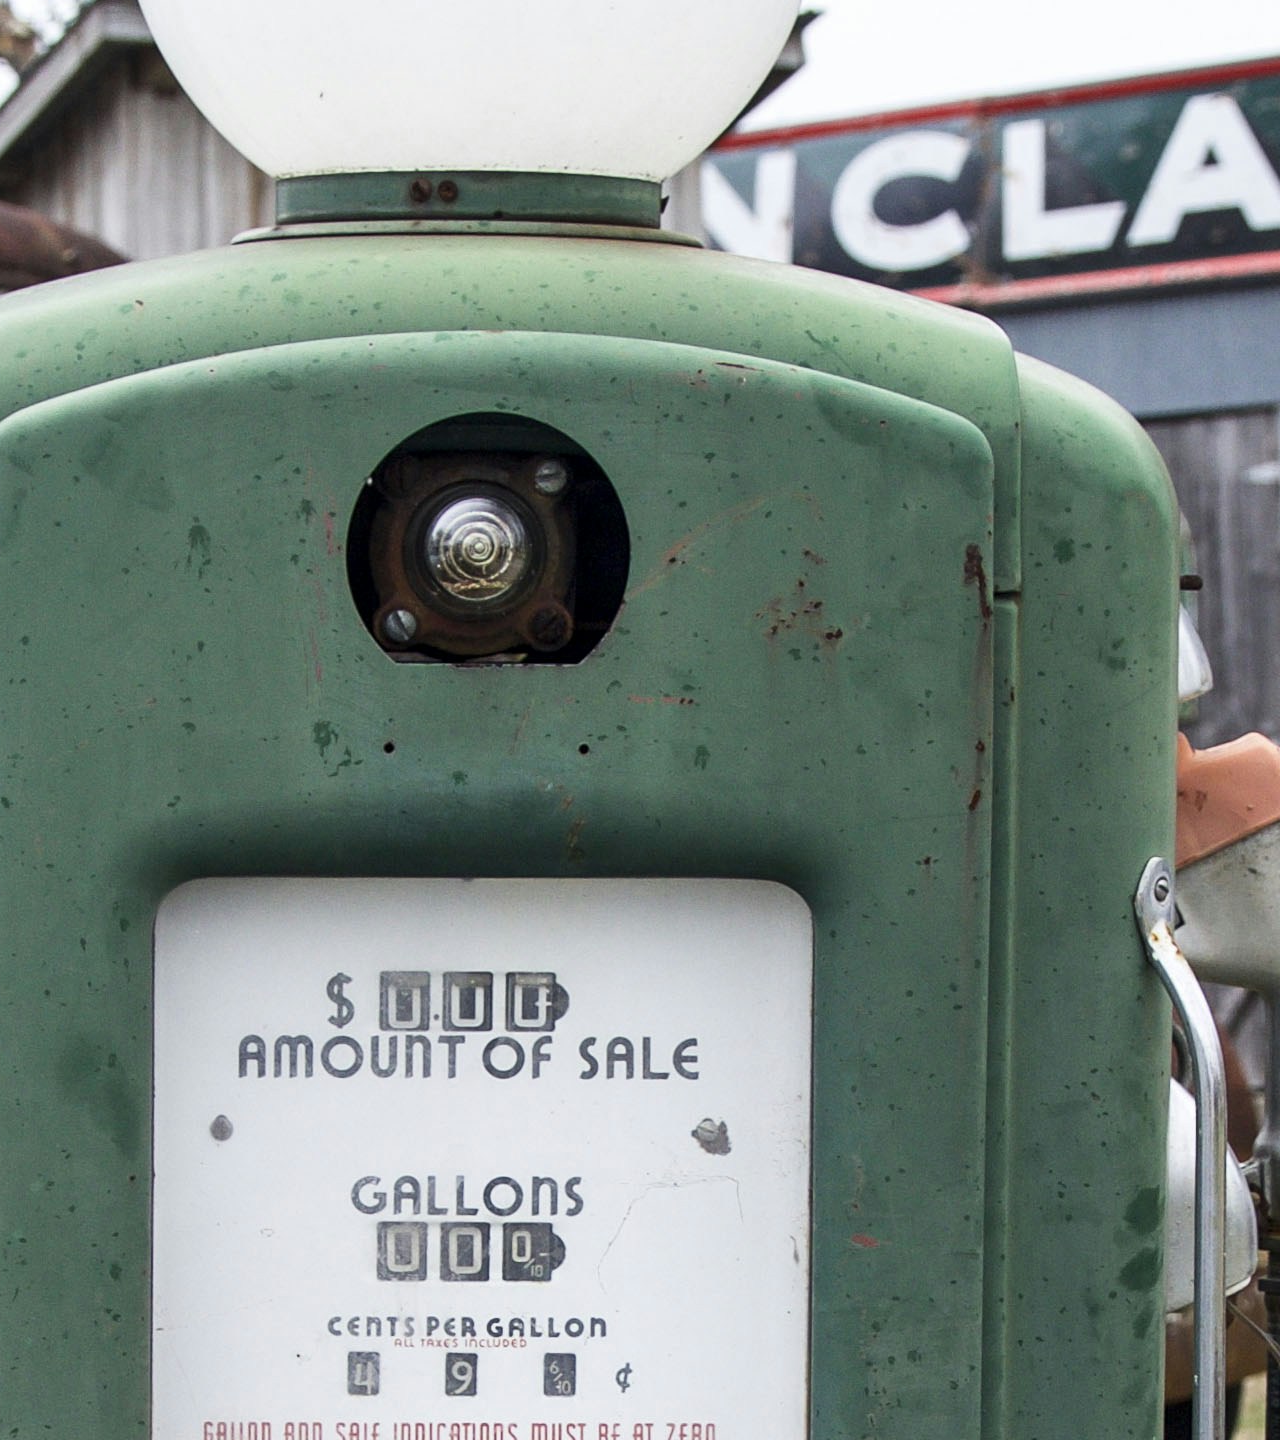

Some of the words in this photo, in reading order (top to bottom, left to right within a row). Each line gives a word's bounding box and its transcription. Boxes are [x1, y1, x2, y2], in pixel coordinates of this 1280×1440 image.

[238, 1034, 465, 1079] AMOUNT
[482, 1035, 553, 1080] OF
[579, 1036, 700, 1080] SALE
[350, 1175, 584, 1217] GALLONS
[327, 1315, 415, 1337] CENTS
[426, 1316, 476, 1337] PER
[486, 1317, 607, 1337] GALLON
[395, 1338, 414, 1347] ALL
[421, 1338, 459, 1348] TAXES
[465, 1339, 527, 1348] INCLUDED
